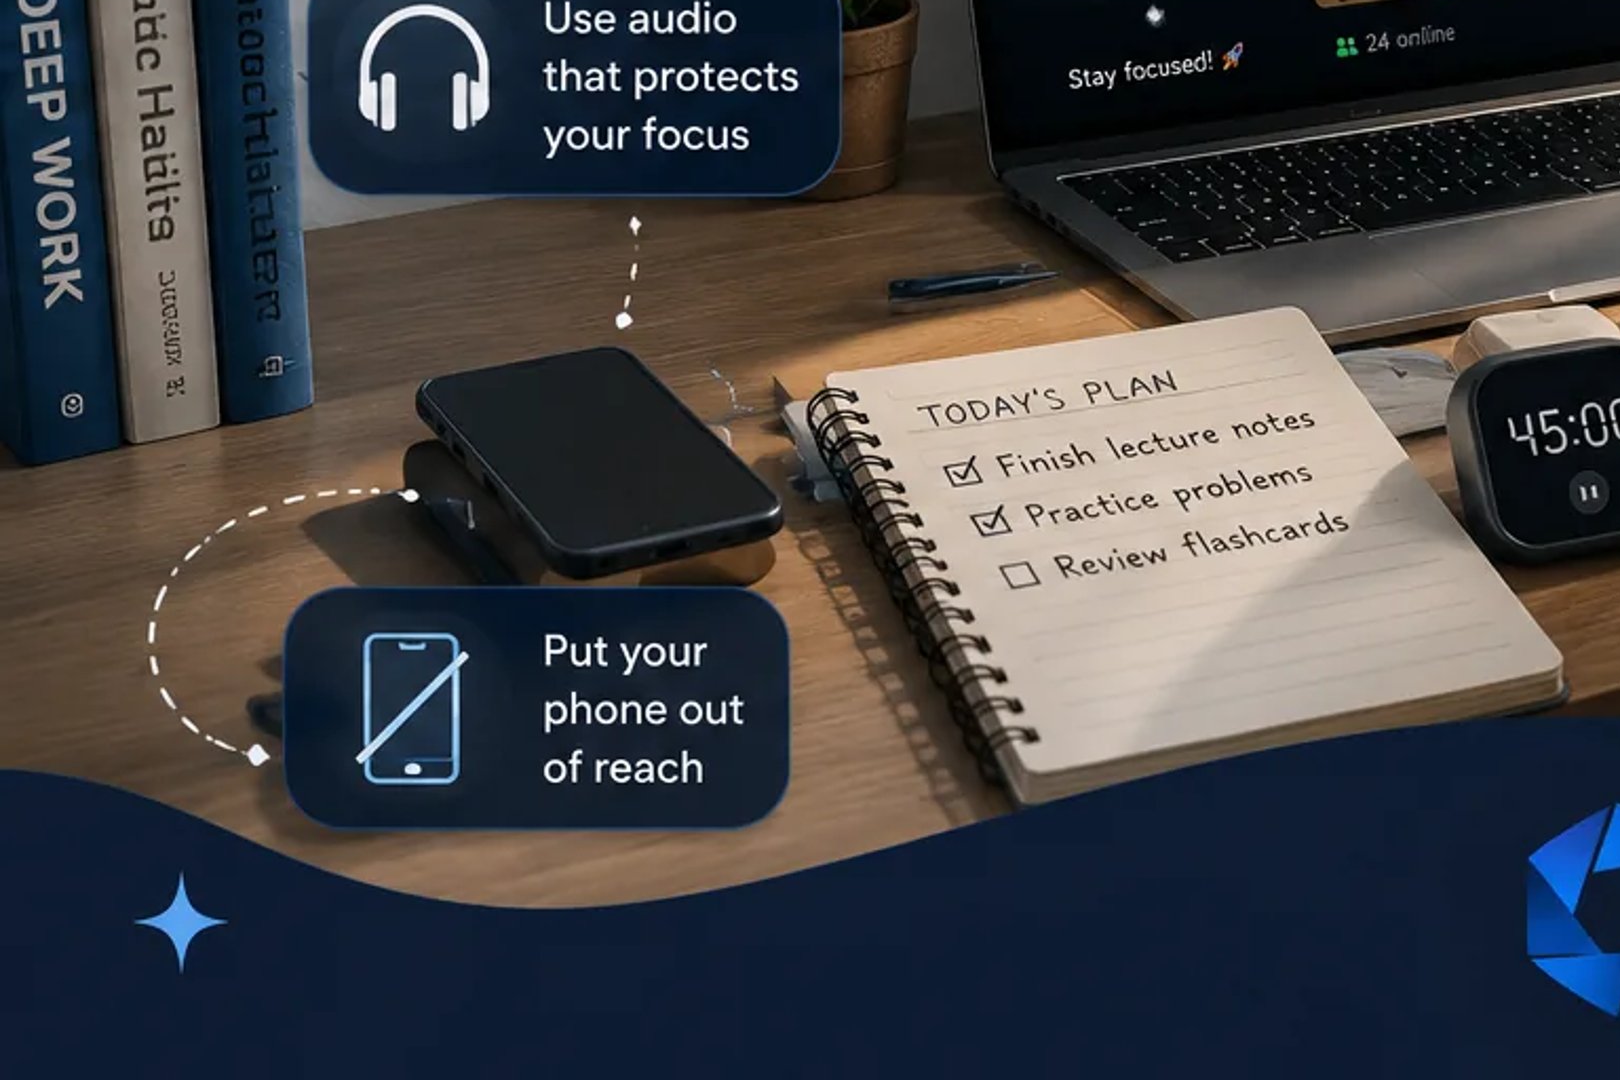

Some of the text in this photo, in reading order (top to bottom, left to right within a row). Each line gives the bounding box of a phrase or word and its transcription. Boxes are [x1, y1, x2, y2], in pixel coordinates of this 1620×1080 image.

[1068, 50, 1213, 91] Stay focused!
[1366, 32, 1389, 52] 24
[32, 137, 83, 309] WORK
[917, 370, 1178, 428] TODAY'S PLAN
[996, 409, 1316, 479] Finish lecture notes
[1025, 464, 1314, 528] Practice problems
[1054, 510, 1350, 580] Review flashcards
